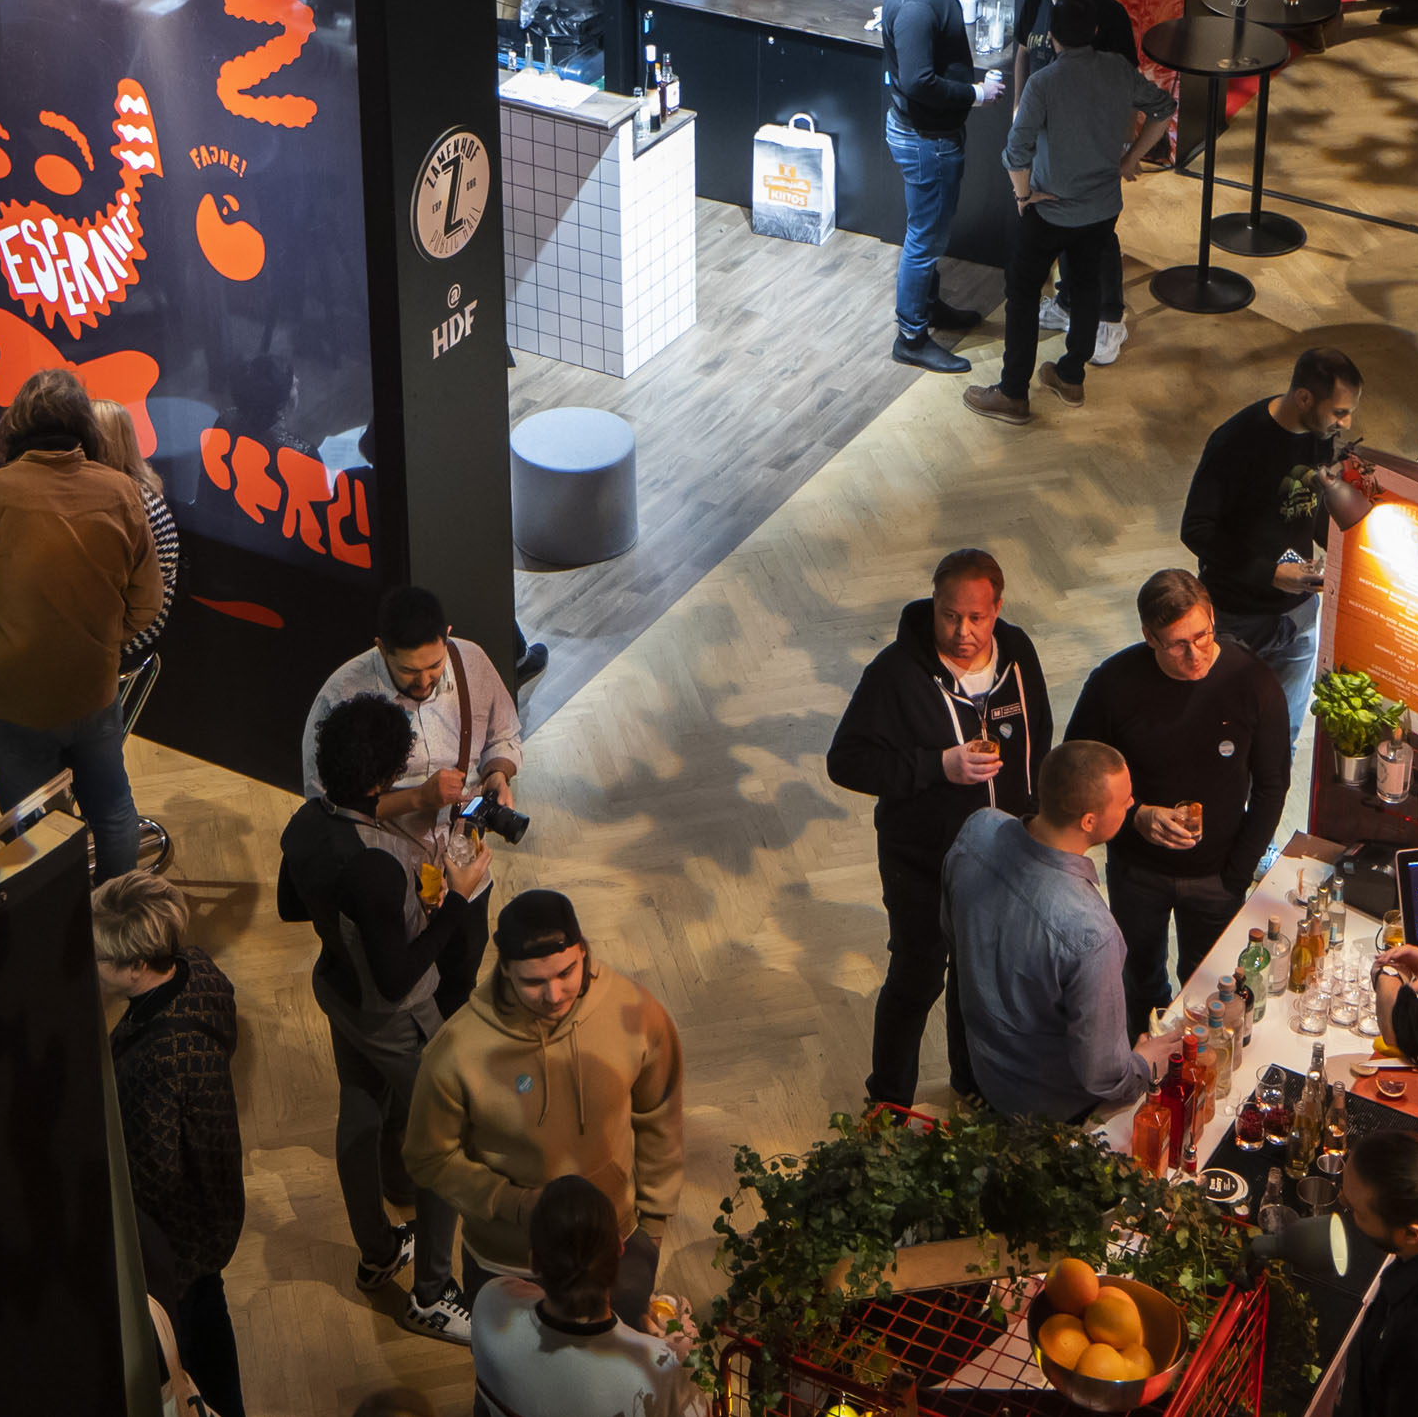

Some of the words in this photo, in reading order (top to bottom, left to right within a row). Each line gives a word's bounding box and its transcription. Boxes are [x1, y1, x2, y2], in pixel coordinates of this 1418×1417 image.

[189, 145, 247, 178] FAJNE!
[425, 139, 482, 190] ZAMENHOF
[771, 190, 806, 207] KIITOS
[428, 228, 460, 254] PUBLIC
[461, 204, 484, 238] HALL
[446, 284, 462, 309] @
[431, 300, 479, 360] HDF
